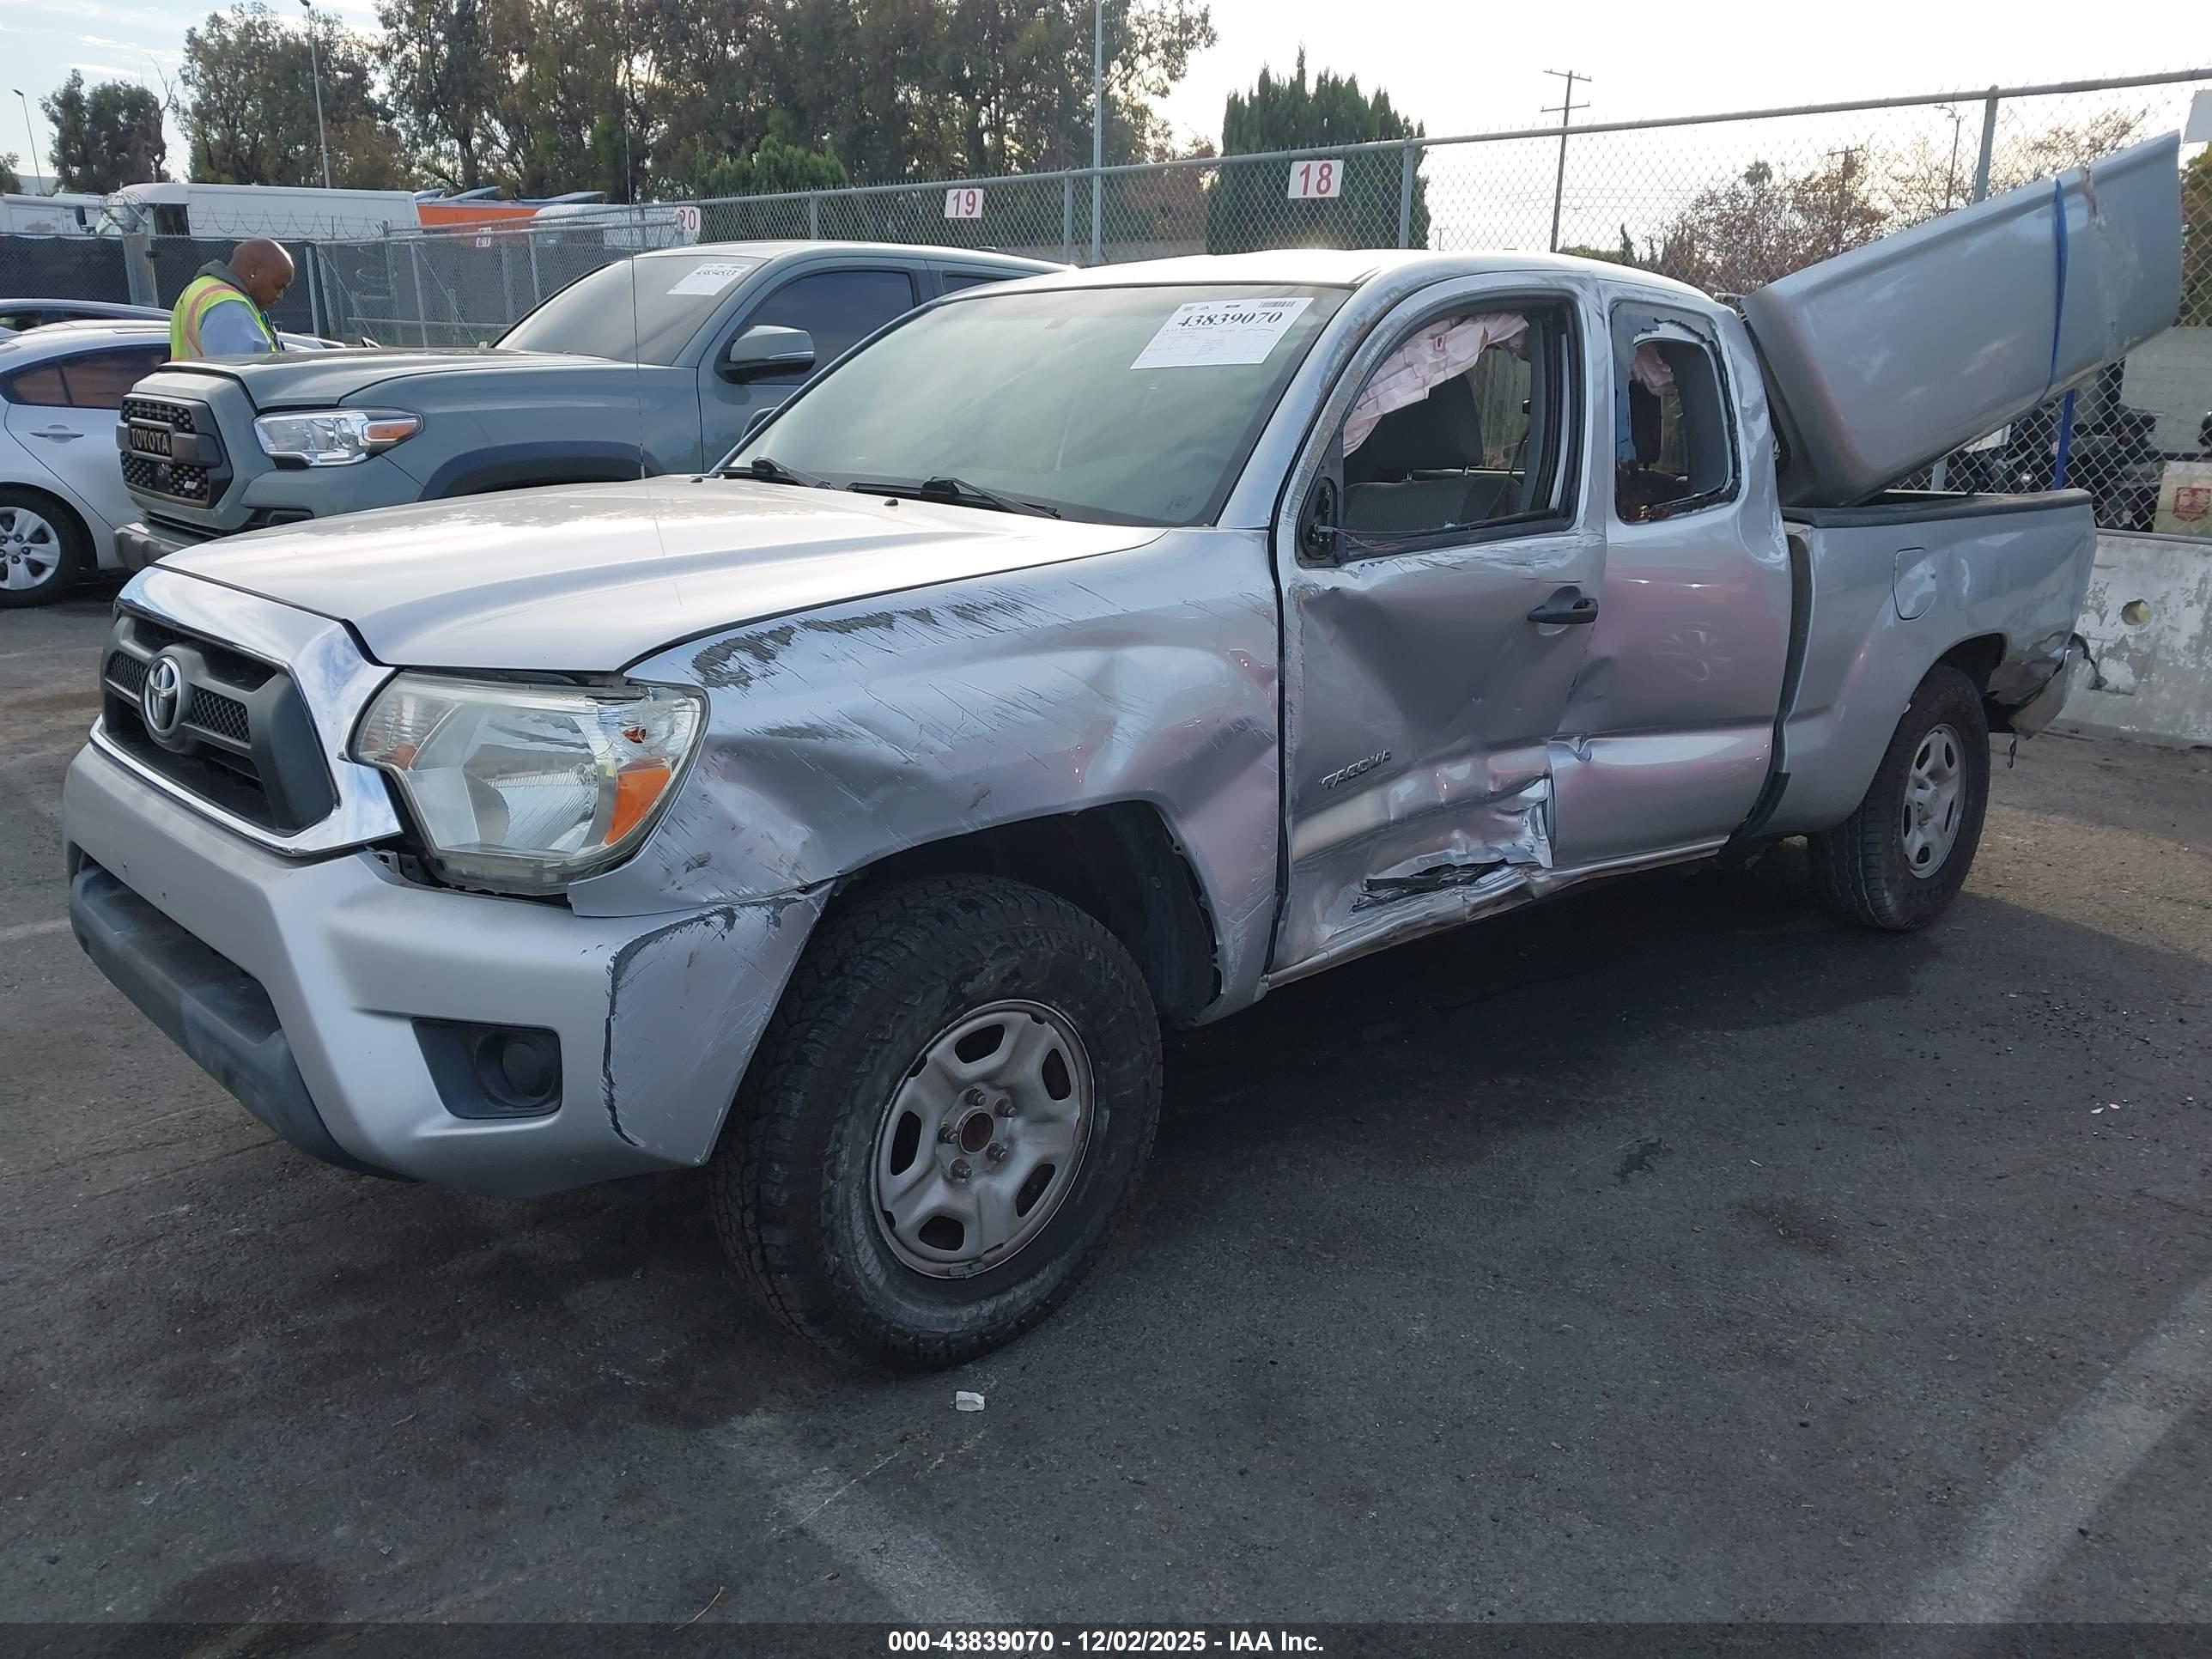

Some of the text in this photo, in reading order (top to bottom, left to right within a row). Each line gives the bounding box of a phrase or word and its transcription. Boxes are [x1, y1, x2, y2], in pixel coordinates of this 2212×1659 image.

[1299, 163, 1333, 196] 18
[952, 190, 976, 216] 19
[1177, 311, 1284, 328] 43839070
[131, 426, 171, 455] TOYOTA
[1318, 750, 1392, 789] TACOMA
